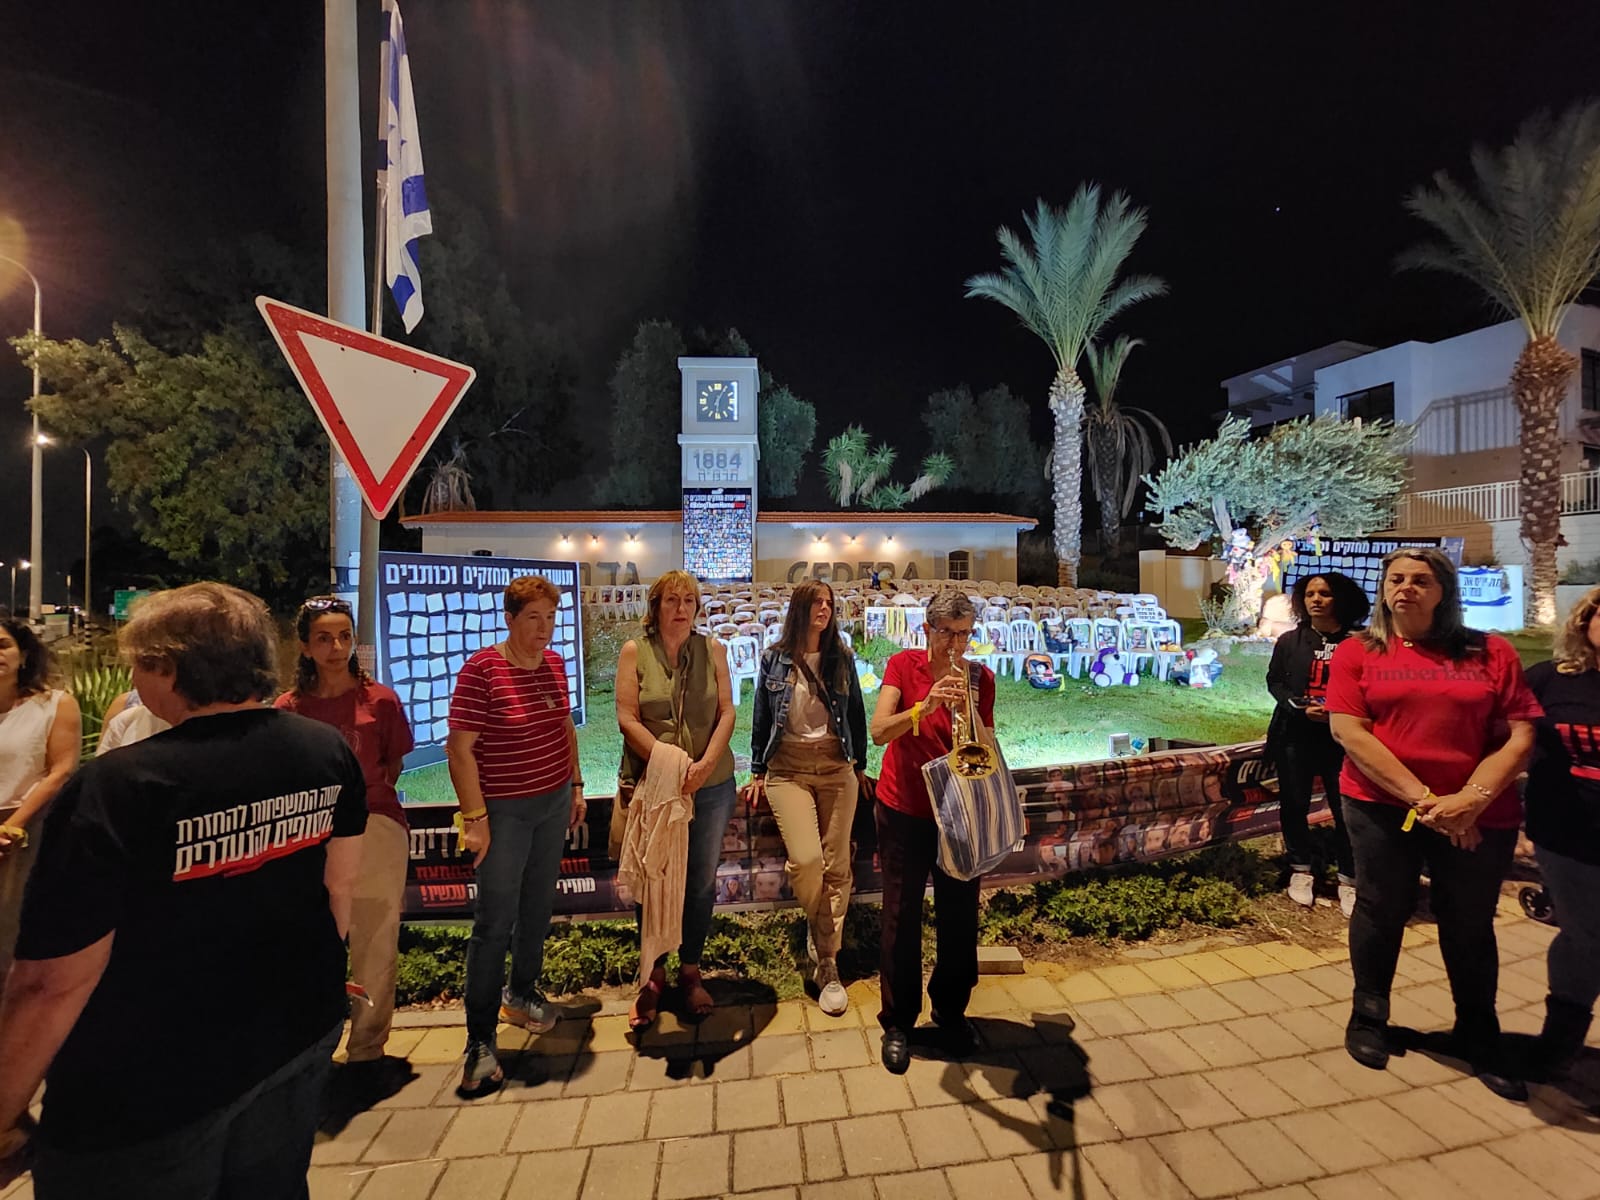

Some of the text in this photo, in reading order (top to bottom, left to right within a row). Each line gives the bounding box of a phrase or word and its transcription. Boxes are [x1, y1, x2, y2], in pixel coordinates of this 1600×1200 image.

[694, 452, 741, 469] 1884
[1333, 541, 1369, 555] מחזקים
[386, 563, 457, 585] וכותבים
[463, 565, 510, 590] מחזקים
[251, 789, 319, 825] המשפחות
[176, 804, 248, 844] להחזרת
[174, 824, 272, 875] והנעדרים
